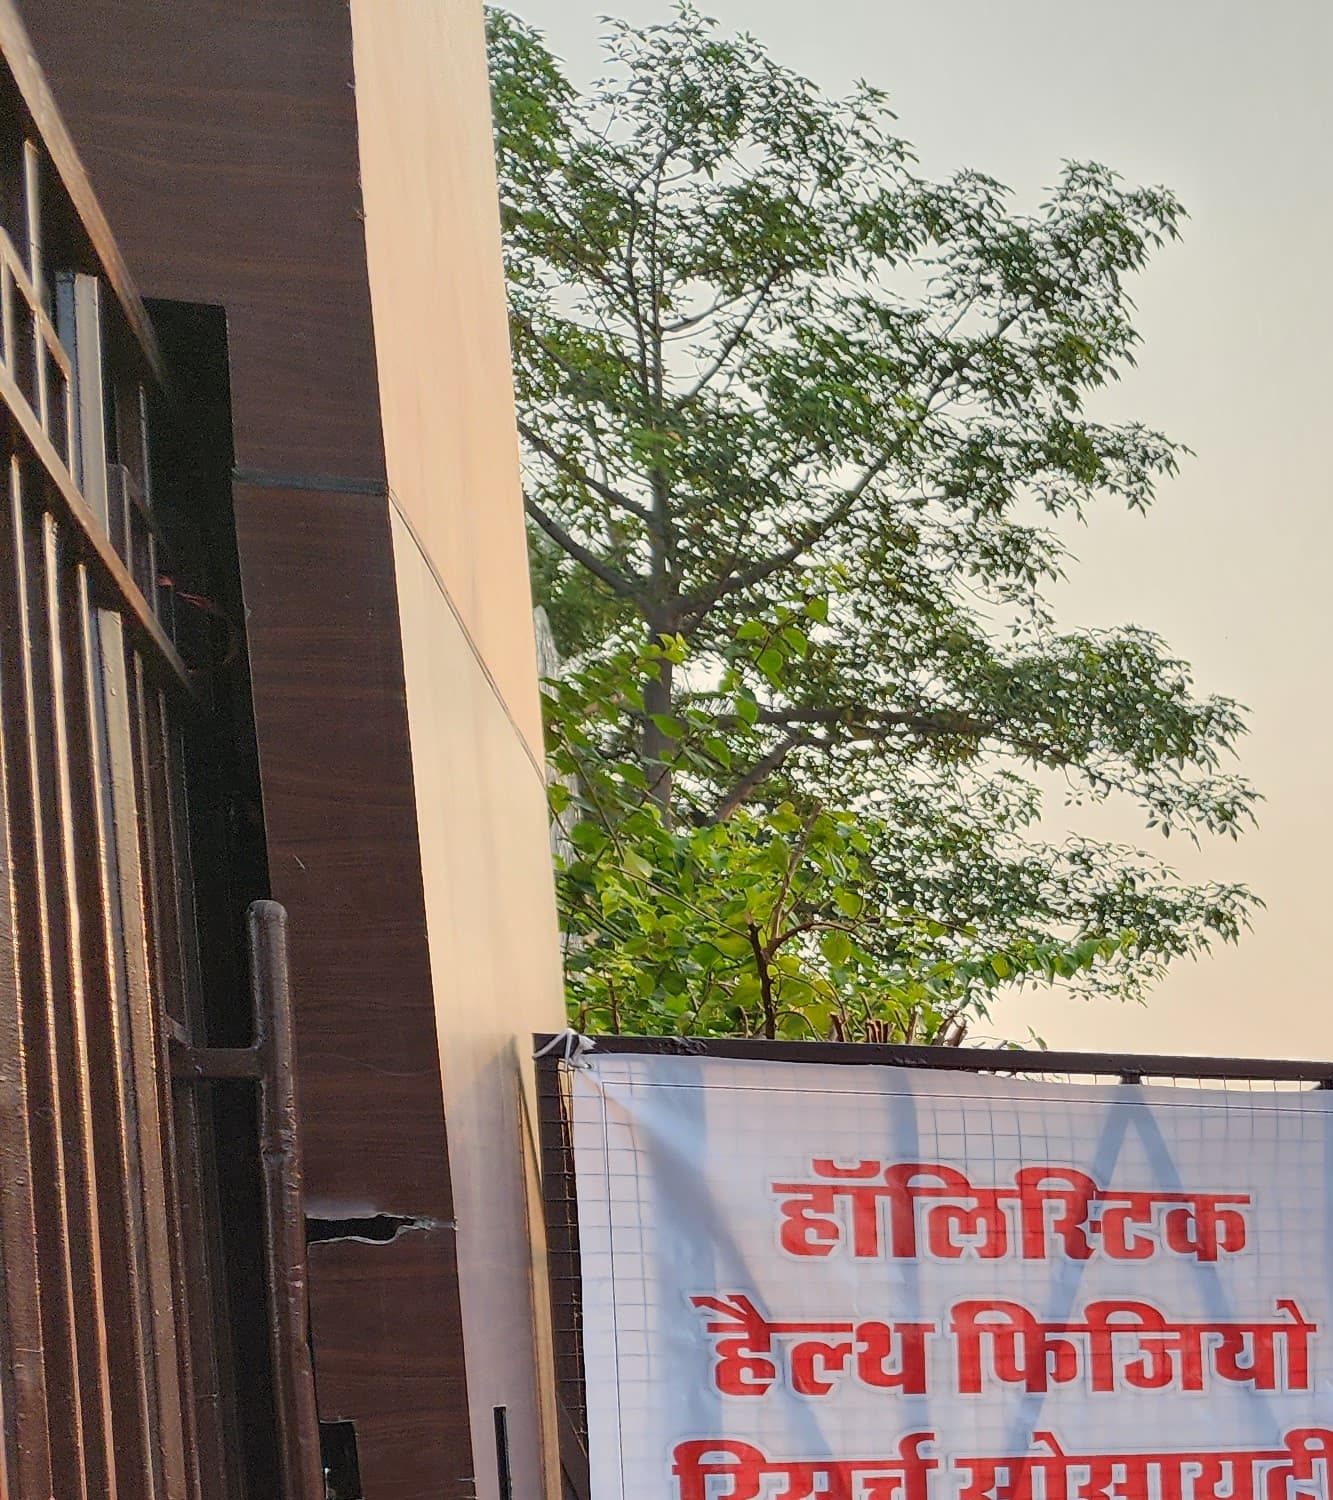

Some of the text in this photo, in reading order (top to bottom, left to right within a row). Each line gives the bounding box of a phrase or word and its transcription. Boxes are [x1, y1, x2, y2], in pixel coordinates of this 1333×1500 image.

[772, 1159, 1250, 1262] हॉलिस्टिक
[692, 1294, 1318, 1396] हैल्थ फिजियो
